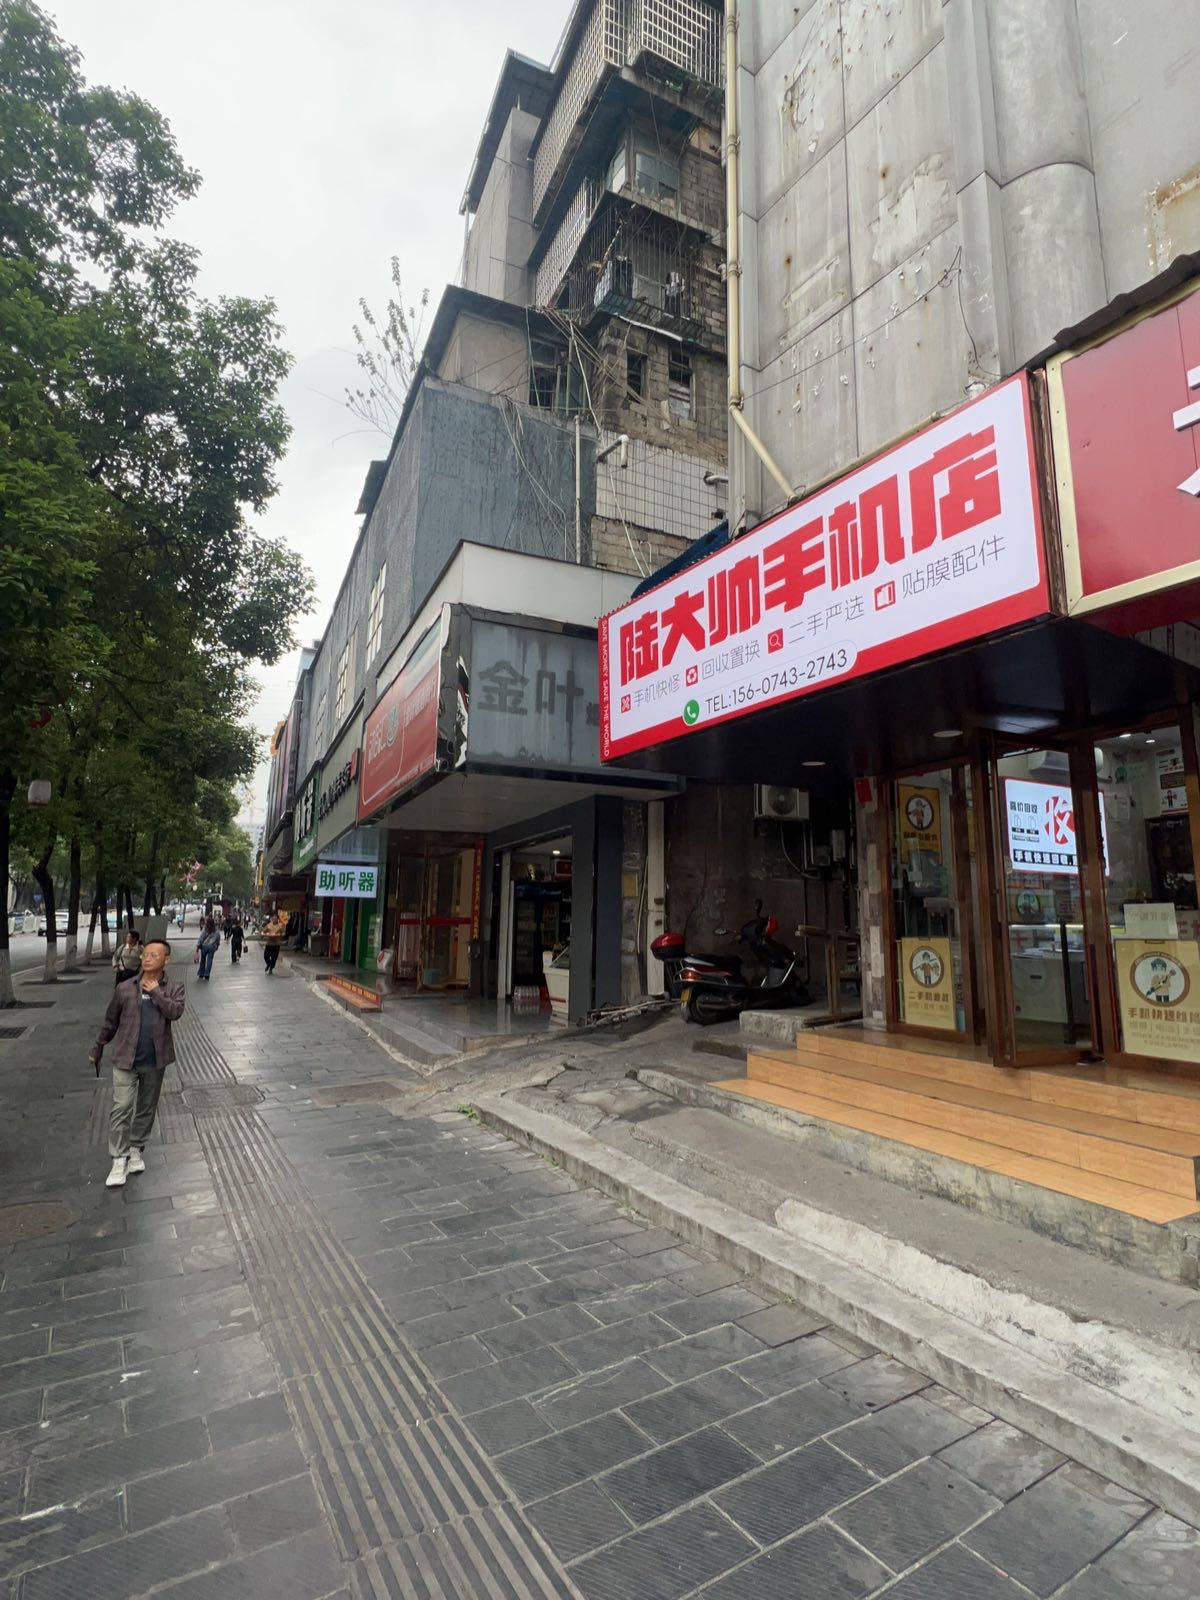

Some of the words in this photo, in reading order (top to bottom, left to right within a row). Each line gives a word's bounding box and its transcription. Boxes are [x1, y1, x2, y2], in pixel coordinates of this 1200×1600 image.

[620, 425, 1002, 687] 陆大帅手机店
[902, 534, 1006, 599] 贴膜配件
[789, 595, 865, 645] 二手严选
[702, 640, 761, 680] 回收置换
[705, 649, 848, 715] TEL:156-0743-2743
[634, 674, 681, 708] 手机快修
[318, 869, 376, 895] 助听器
